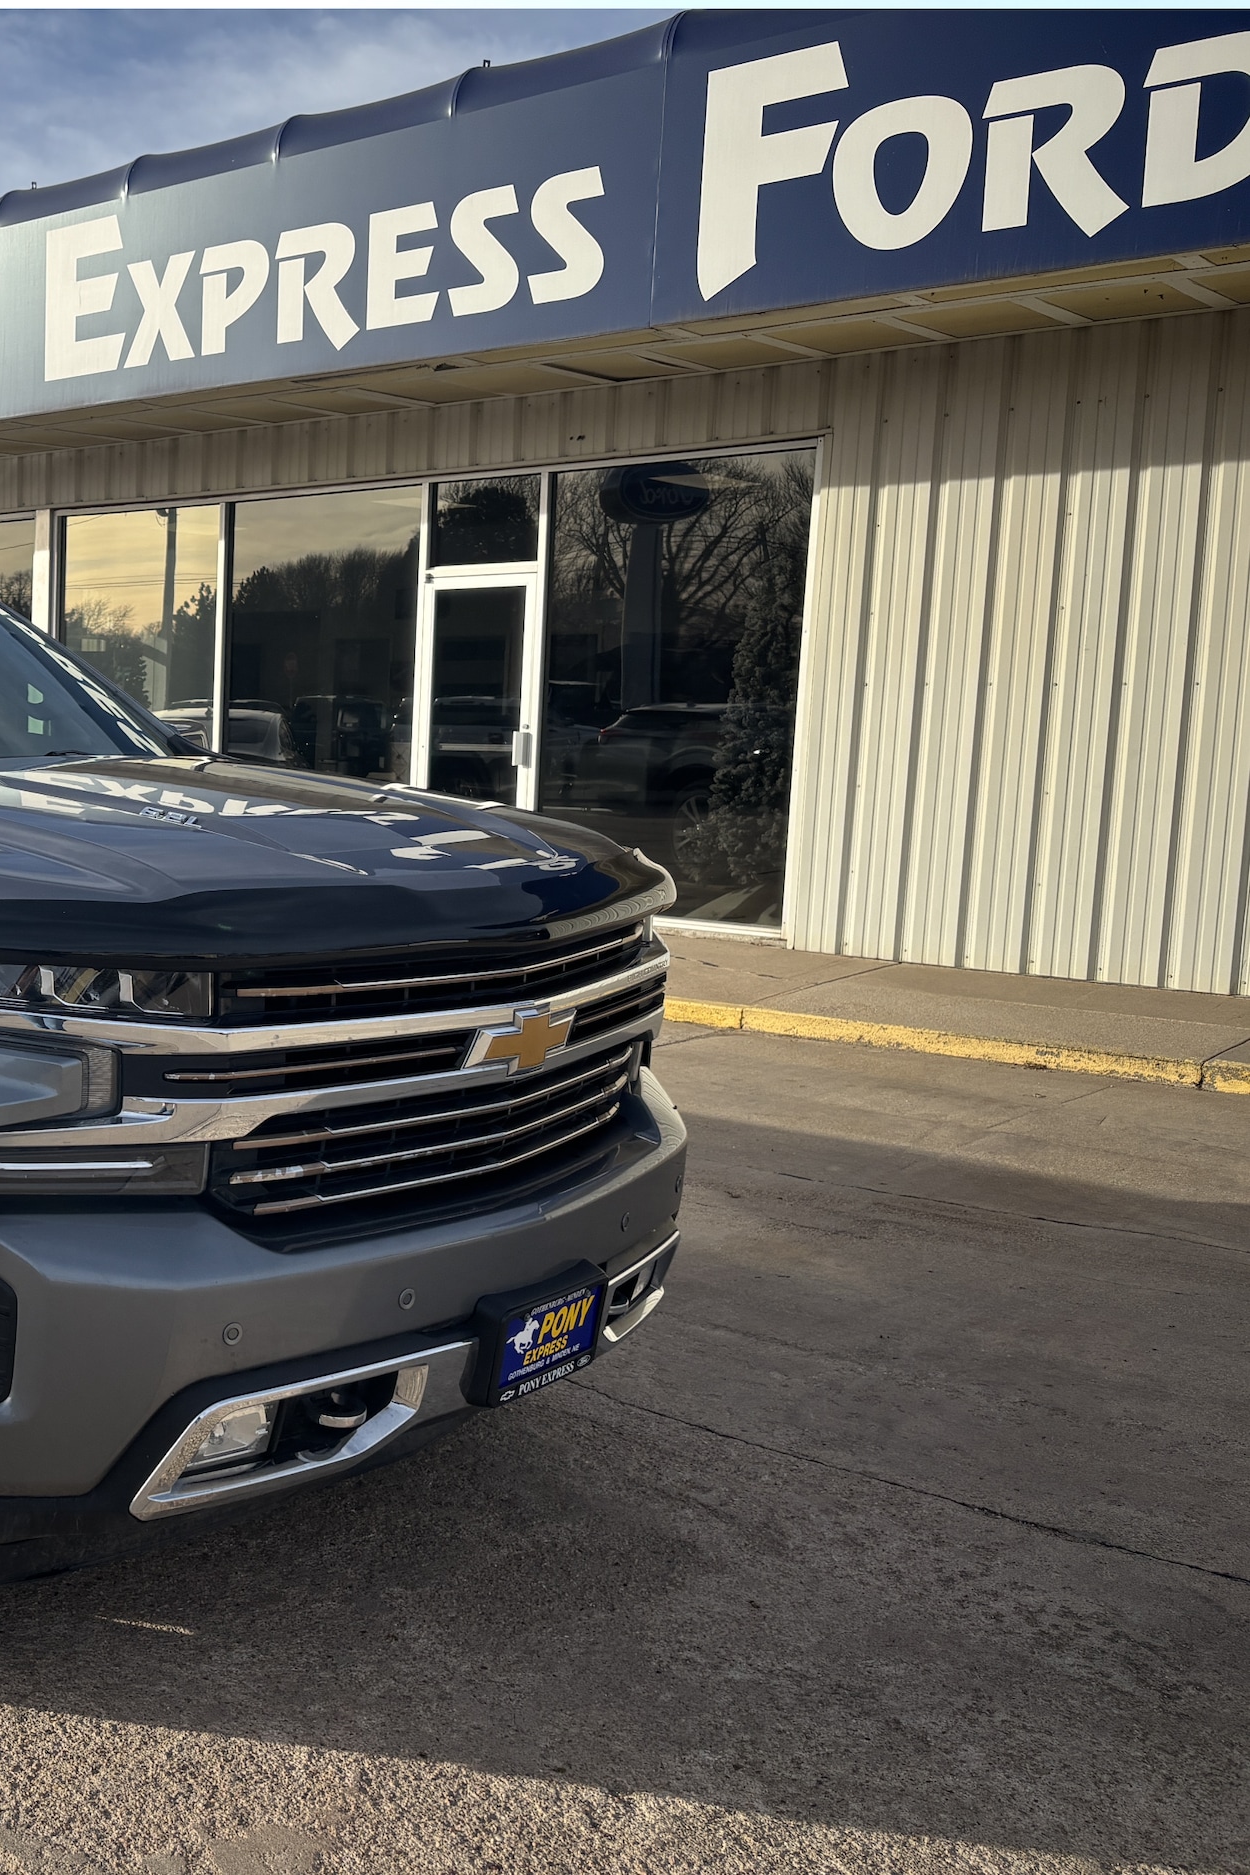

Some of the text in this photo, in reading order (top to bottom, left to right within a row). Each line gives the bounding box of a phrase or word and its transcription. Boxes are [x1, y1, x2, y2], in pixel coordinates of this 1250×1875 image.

[44, 165, 606, 382] EXPRESS
[696, 30, 1250, 302] FORD
[537, 1295, 595, 1344] PONY
[507, 1359, 545, 1381] GOTHENBURG
[571, 1343, 581, 1352] NE
[523, 1335, 568, 1366] EXPRESS
[518, 1376, 542, 1396] PONY
[542, 1361, 575, 1385] EXPRESS
